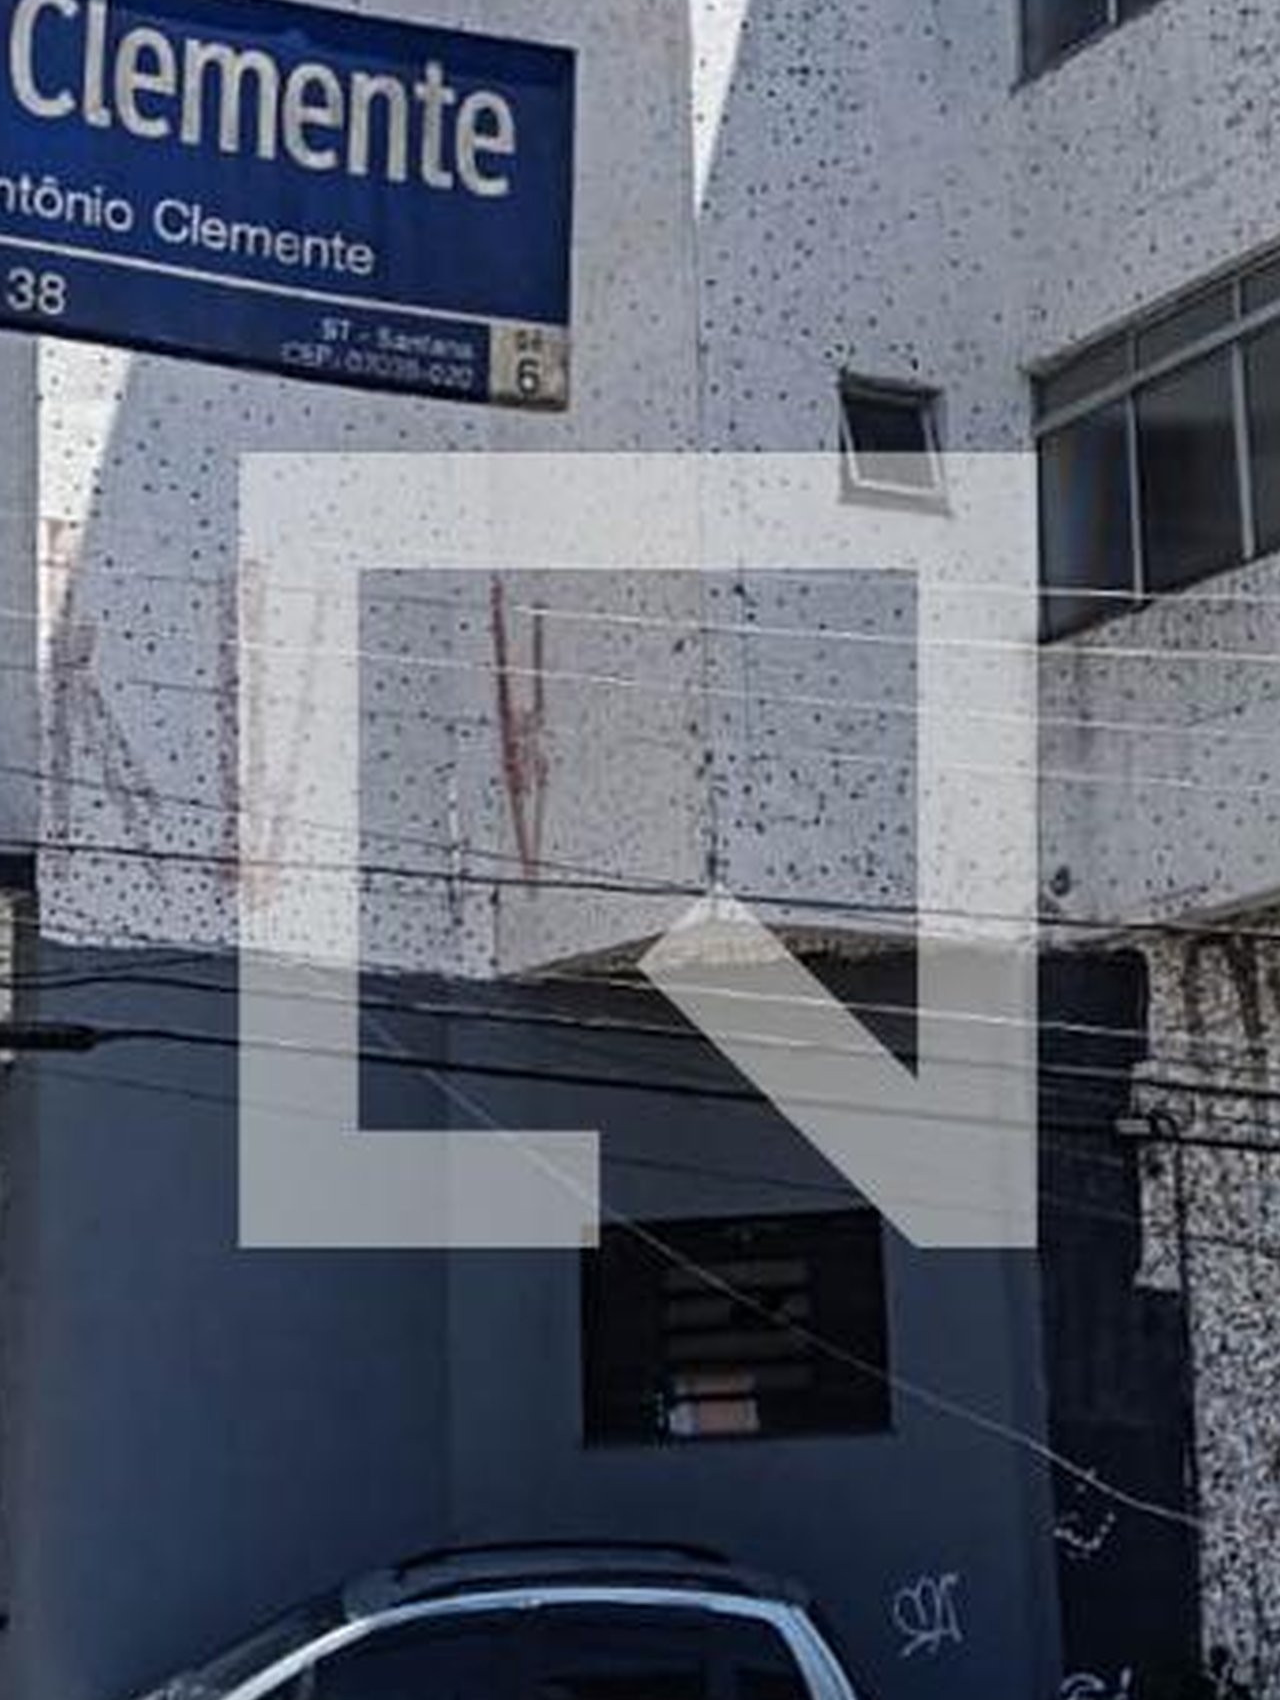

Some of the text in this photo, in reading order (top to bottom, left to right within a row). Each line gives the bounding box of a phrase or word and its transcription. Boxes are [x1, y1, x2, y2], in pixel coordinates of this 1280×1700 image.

[153, 198, 375, 275] Clemente
[6, 267, 66, 315] 38
[516, 358, 541, 396] 6
